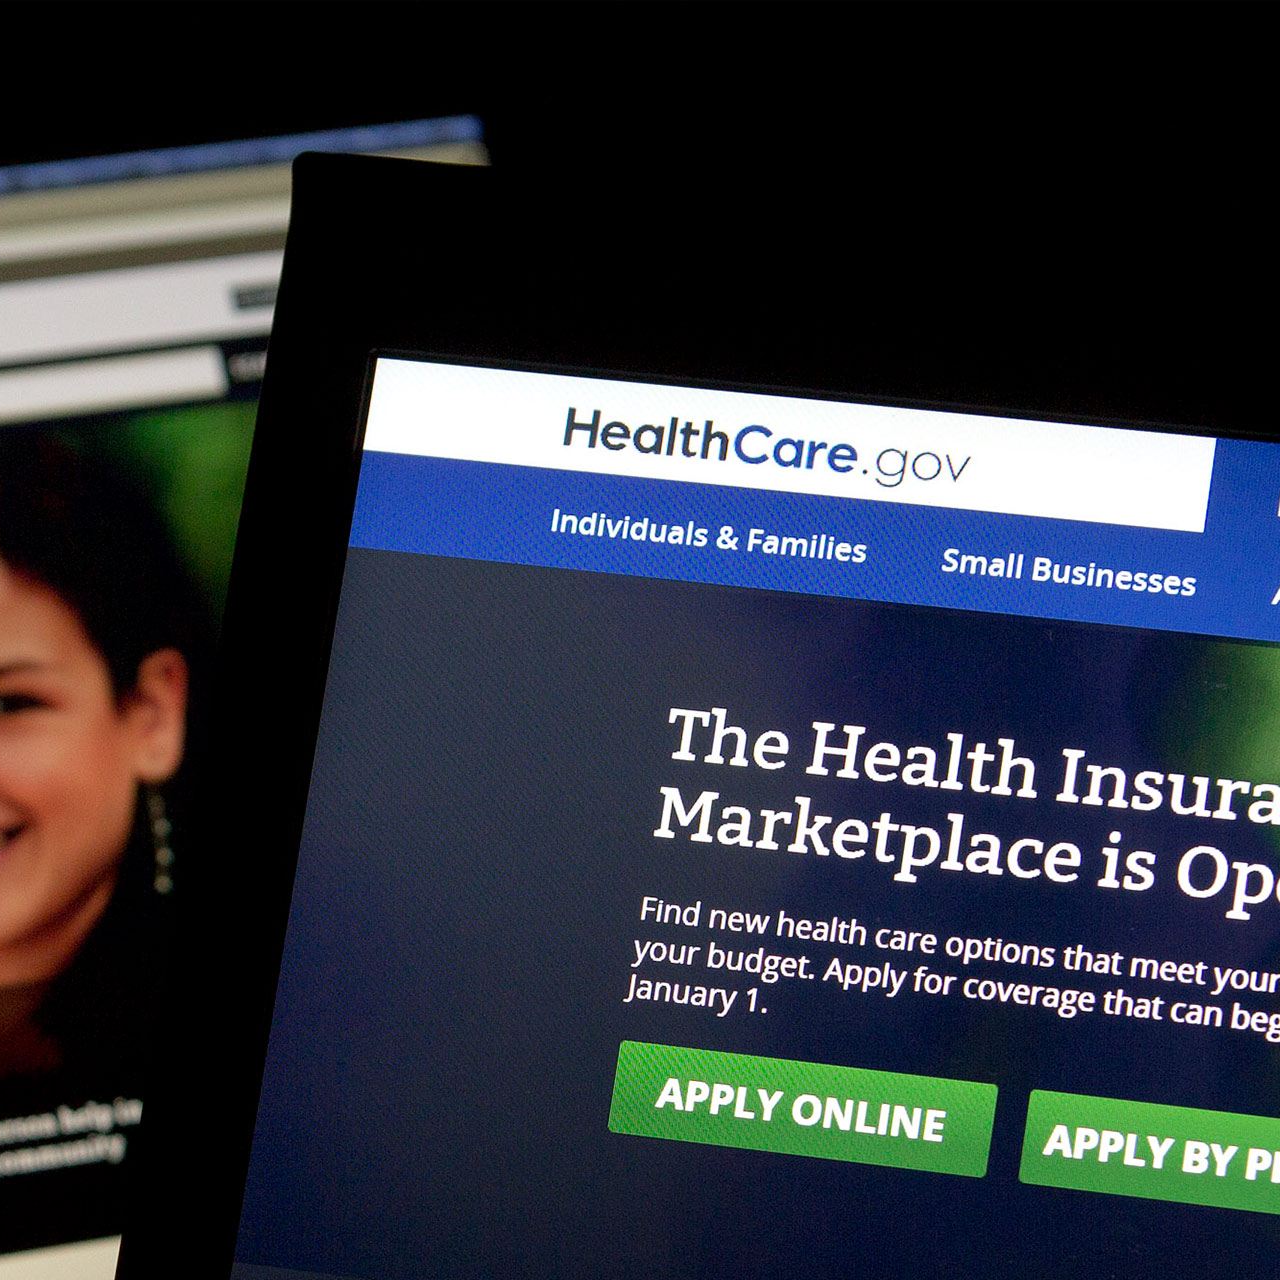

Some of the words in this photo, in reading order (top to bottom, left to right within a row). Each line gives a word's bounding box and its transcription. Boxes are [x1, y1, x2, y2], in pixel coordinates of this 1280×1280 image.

[562, 406, 972, 488] HealthCare.gov
[550, 508, 709, 547] Individuals
[716, 525, 739, 551] &
[746, 528, 868, 564] Families
[941, 548, 1024, 580] Small
[1031, 556, 1197, 597] Businesses
[668, 707, 790, 771] The
[805, 721, 1038, 799] Health
[653, 786, 1082, 883] Marketplace
[1097, 830, 1156, 892] is
[640, 896, 702, 927] Find
[708, 909, 771, 935] new
[776, 910, 867, 946] health
[875, 928, 938, 954] care
[945, 936, 1056, 968] options
[1063, 944, 1125, 976] that
[1129, 957, 1209, 986] meet
[622, 973, 739, 1018] January
[746, 987, 768, 1014] 1.
[630, 939, 701, 968] your
[706, 941, 815, 984] budget.
[822, 957, 908, 998] Apply
[913, 965, 958, 996] for
[963, 978, 1096, 1019] coverage
[1103, 988, 1165, 1021] that
[1170, 1002, 1223, 1027] can
[654, 1077, 785, 1122] APPLY
[791, 1093, 947, 1143] ONLINE
[1042, 1124, 1176, 1170] APPLY
[1181, 1140, 1239, 1177] BY
